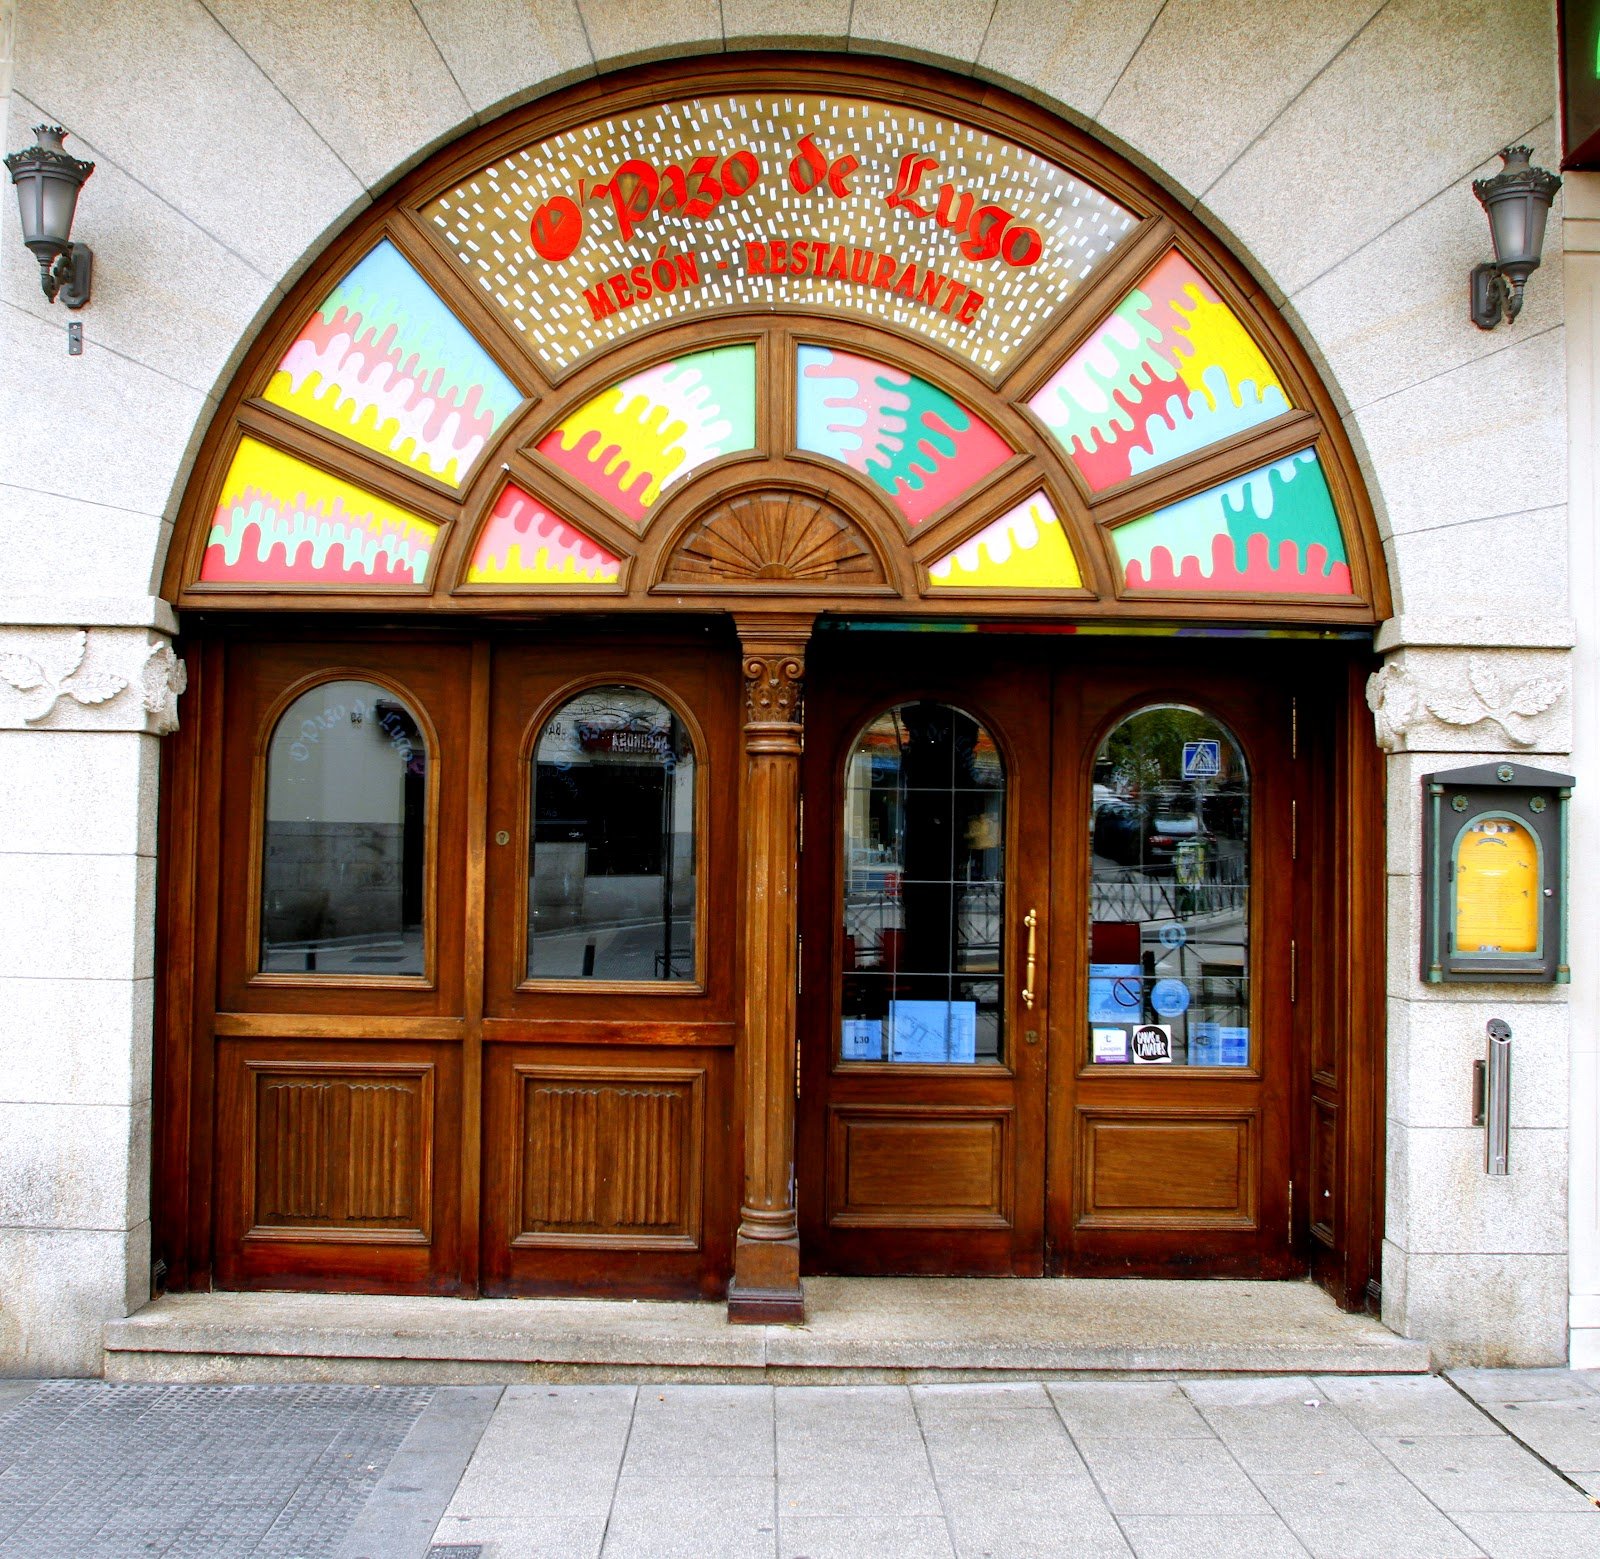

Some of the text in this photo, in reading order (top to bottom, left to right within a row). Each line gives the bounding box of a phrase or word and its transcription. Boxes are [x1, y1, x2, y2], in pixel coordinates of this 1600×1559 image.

[789, 132, 859, 198] de
[884, 152, 1043, 267] Lugo
[582, 245, 700, 322] MESÓN
[744, 240, 985, 326] RESTAURANTE
